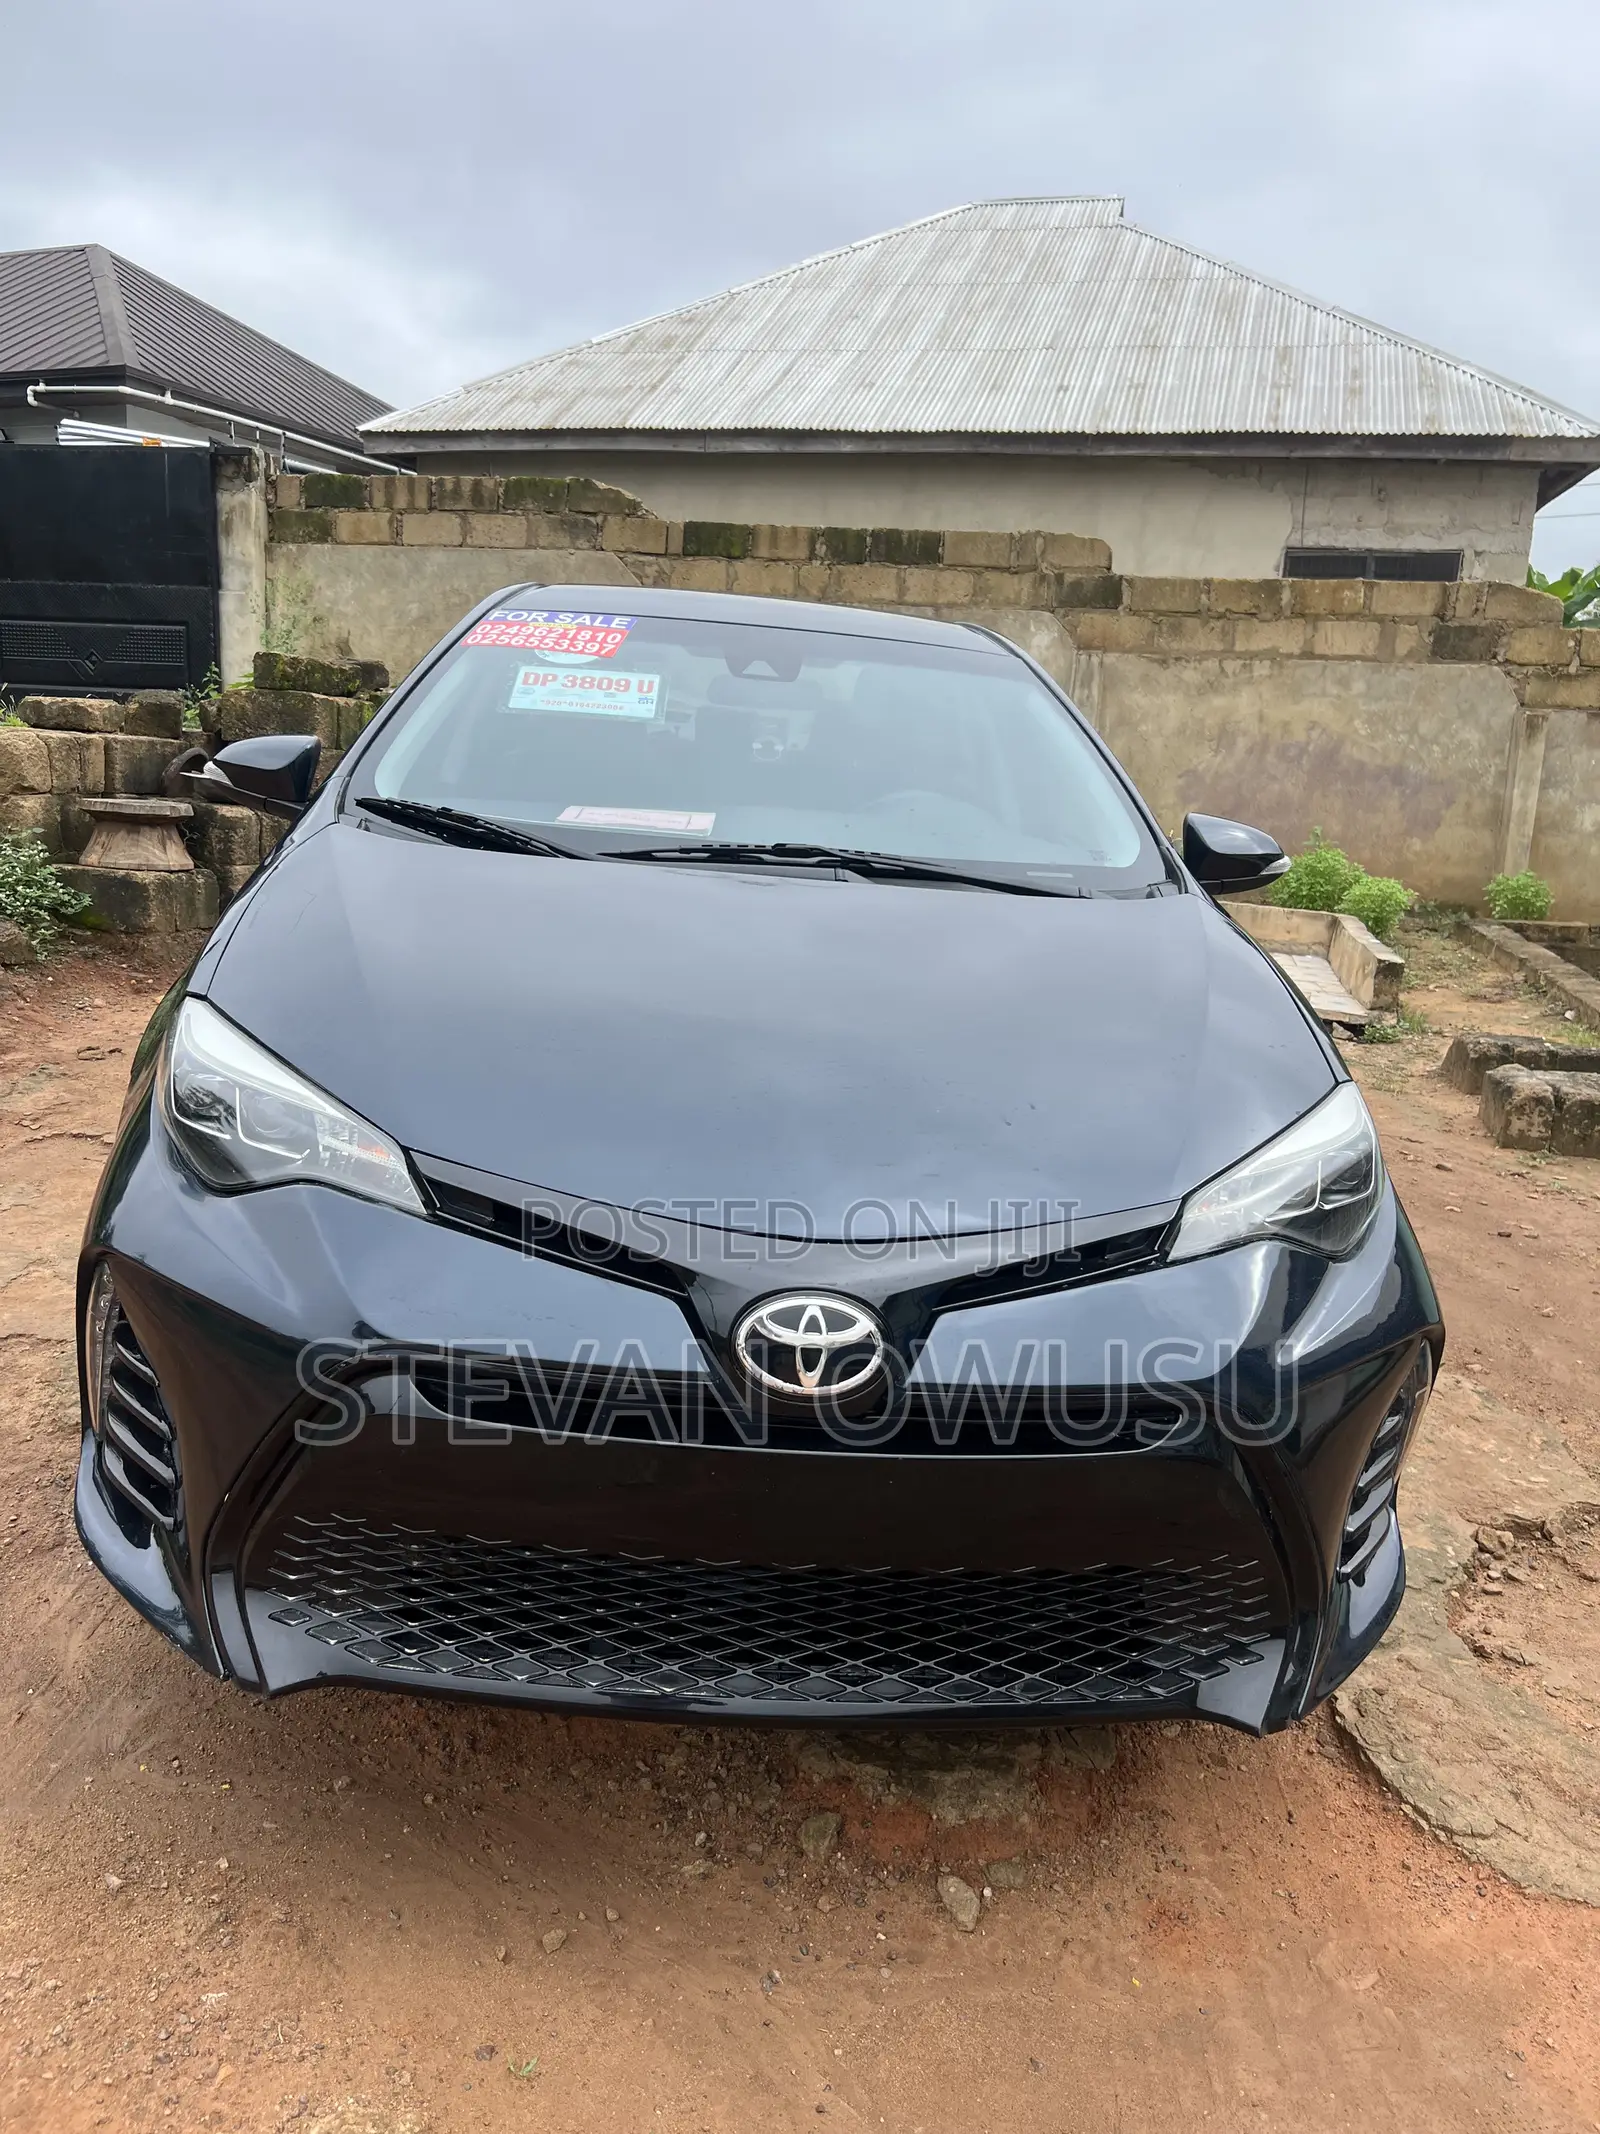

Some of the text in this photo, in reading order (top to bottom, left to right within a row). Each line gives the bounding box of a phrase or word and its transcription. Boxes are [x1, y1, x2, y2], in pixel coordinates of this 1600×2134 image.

[488, 611, 632, 629] FOR SALE
[475, 624, 622, 644] 0249621810
[466, 634, 616, 655] 0256553397
[521, 672, 654, 694] DP 3809 U
